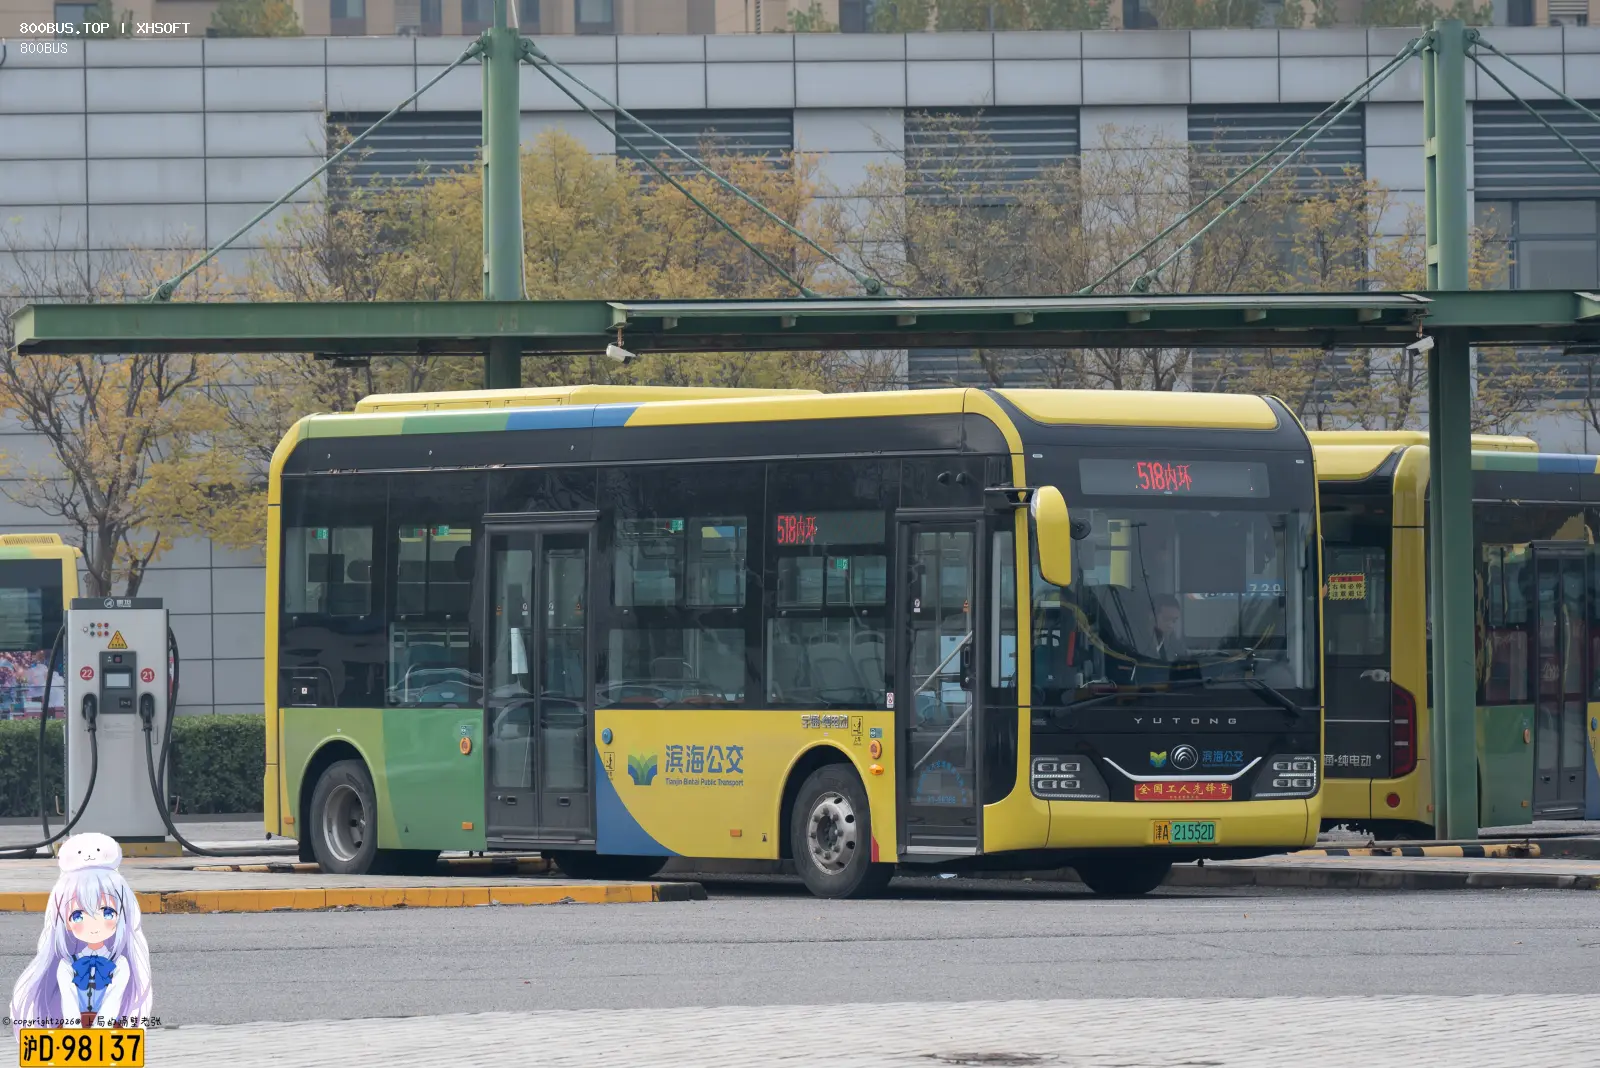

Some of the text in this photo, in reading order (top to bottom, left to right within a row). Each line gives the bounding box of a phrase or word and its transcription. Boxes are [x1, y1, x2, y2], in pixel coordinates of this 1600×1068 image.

[1136, 461, 1193, 491] 518内环
[81, 669, 93, 678] 22
[142, 671, 153, 680] 21
[1133, 717, 1237, 725] YUTONG
[665, 744, 744, 774] 滨海公交
[1202, 750, 1244, 763] 滨海公交
[665, 777, 683, 787] Tianjin
[700, 778, 717, 787] Public
[717, 778, 744, 788] Transport
[1138, 782, 1230, 795] 全国工人先锋号
